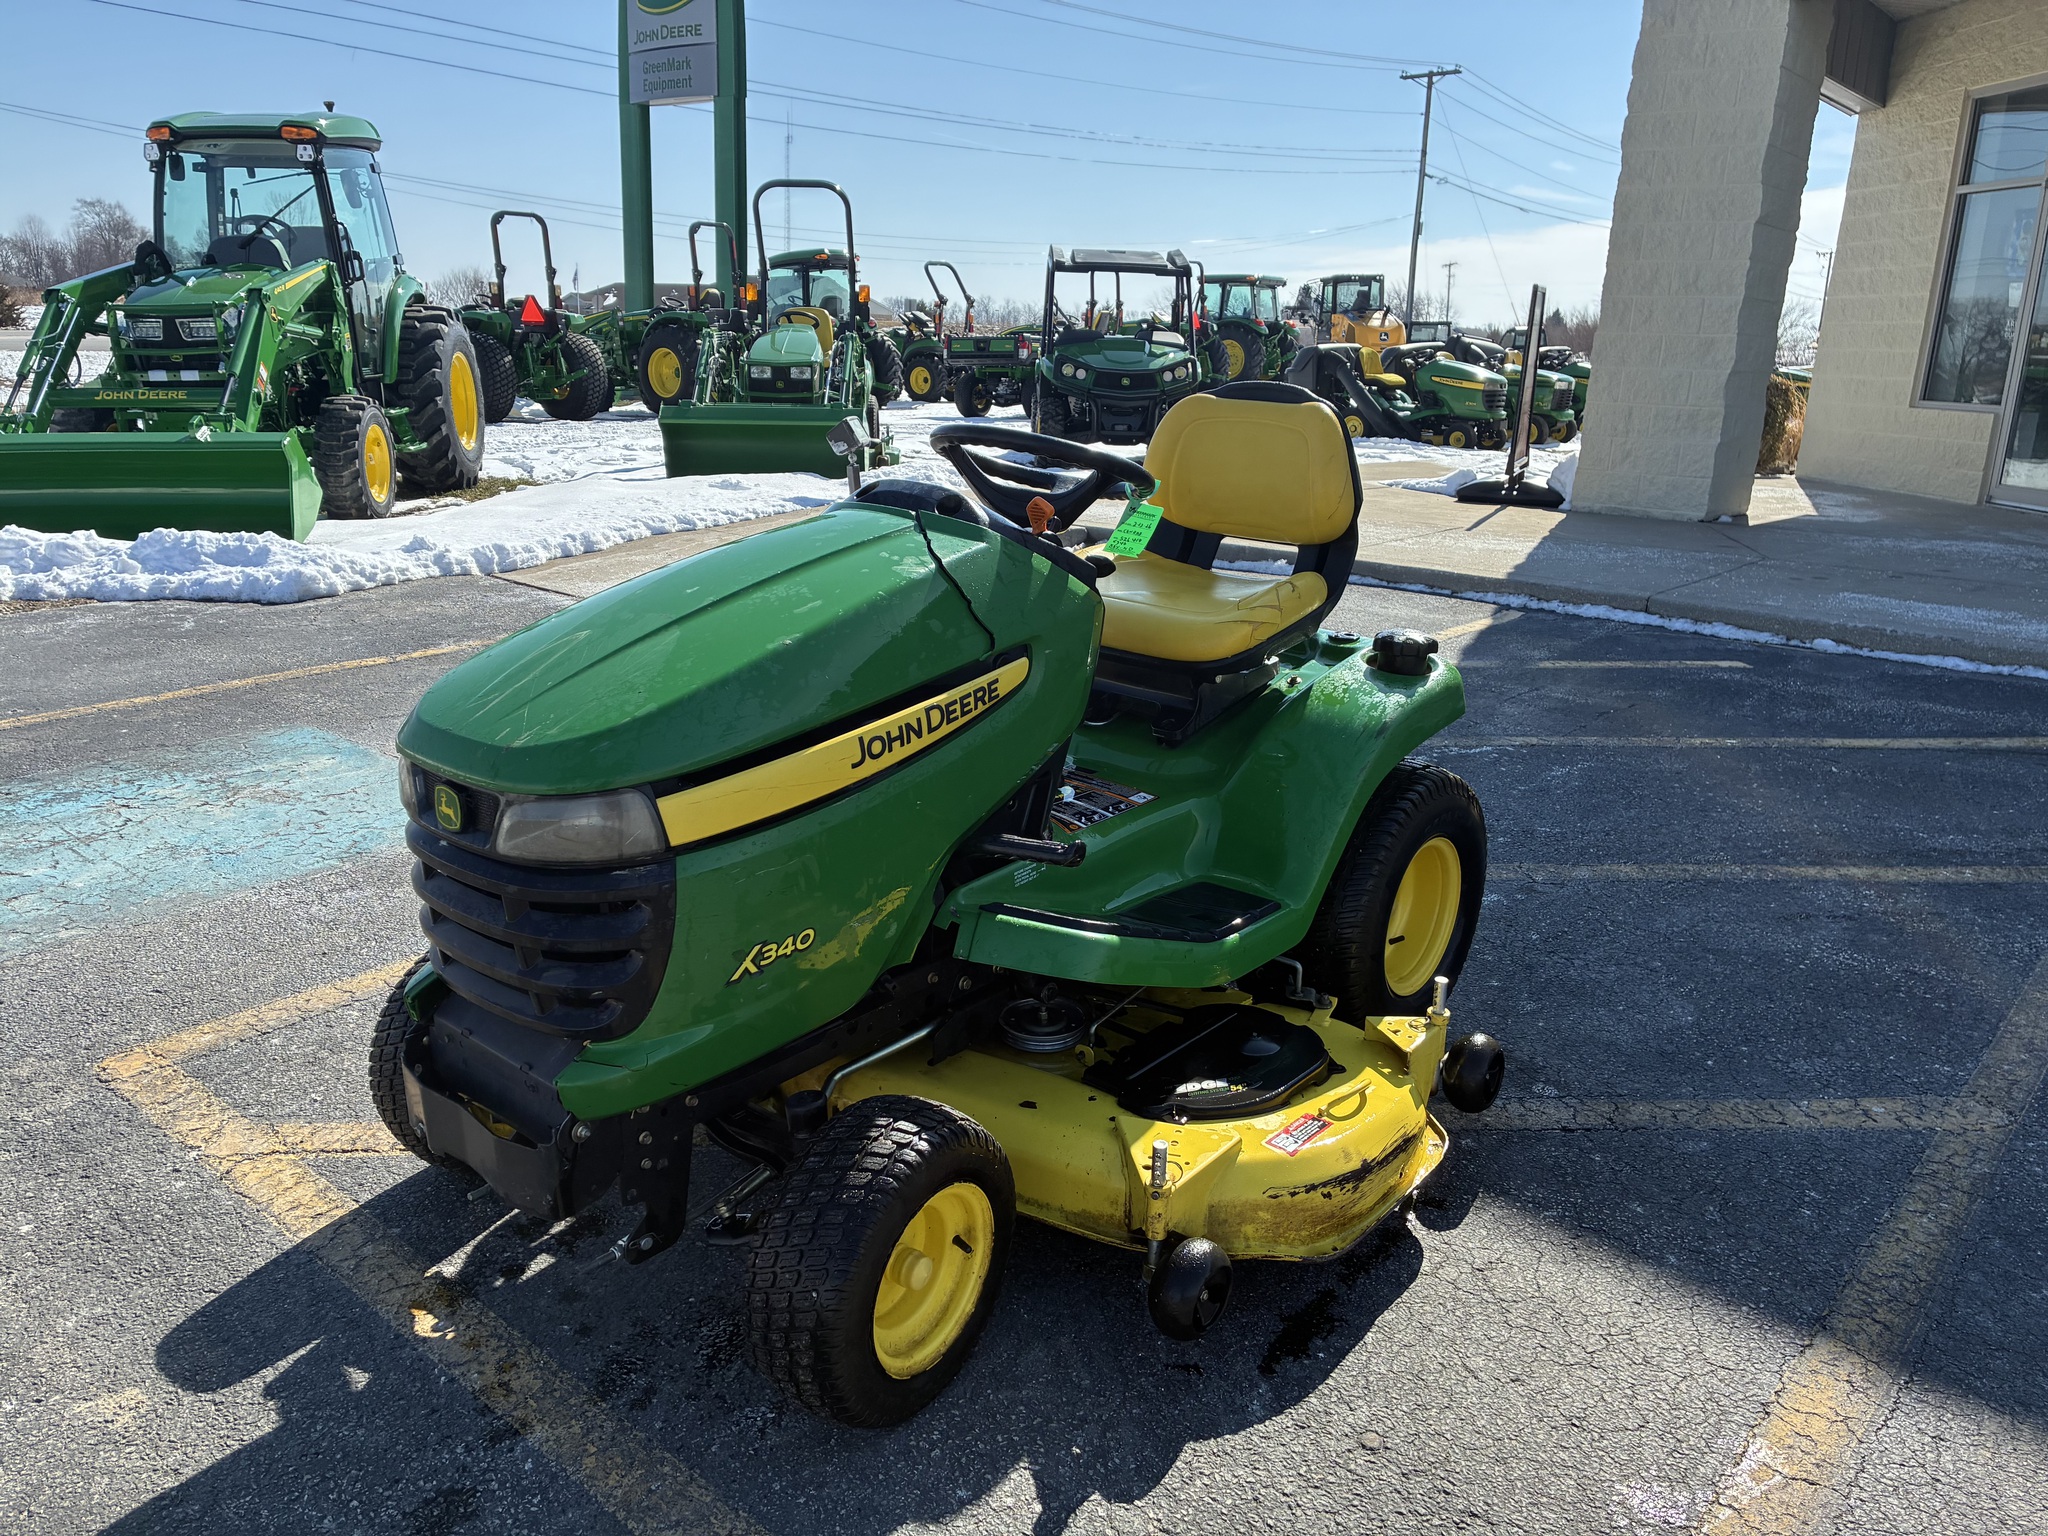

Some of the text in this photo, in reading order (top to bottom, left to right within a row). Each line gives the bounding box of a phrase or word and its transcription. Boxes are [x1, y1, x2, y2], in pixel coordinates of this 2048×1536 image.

[634, 24, 703, 45] JOHN DEERE
[642, 56, 692, 75] GreenMark
[643, 74, 692, 94] Equipment
[94, 389, 188, 400] JOHN DEERE
[851, 678, 1000, 769] JOHN DEERE
[726, 927, 816, 985] X340
[1210, 1086, 1230, 1094] SYSTEM
